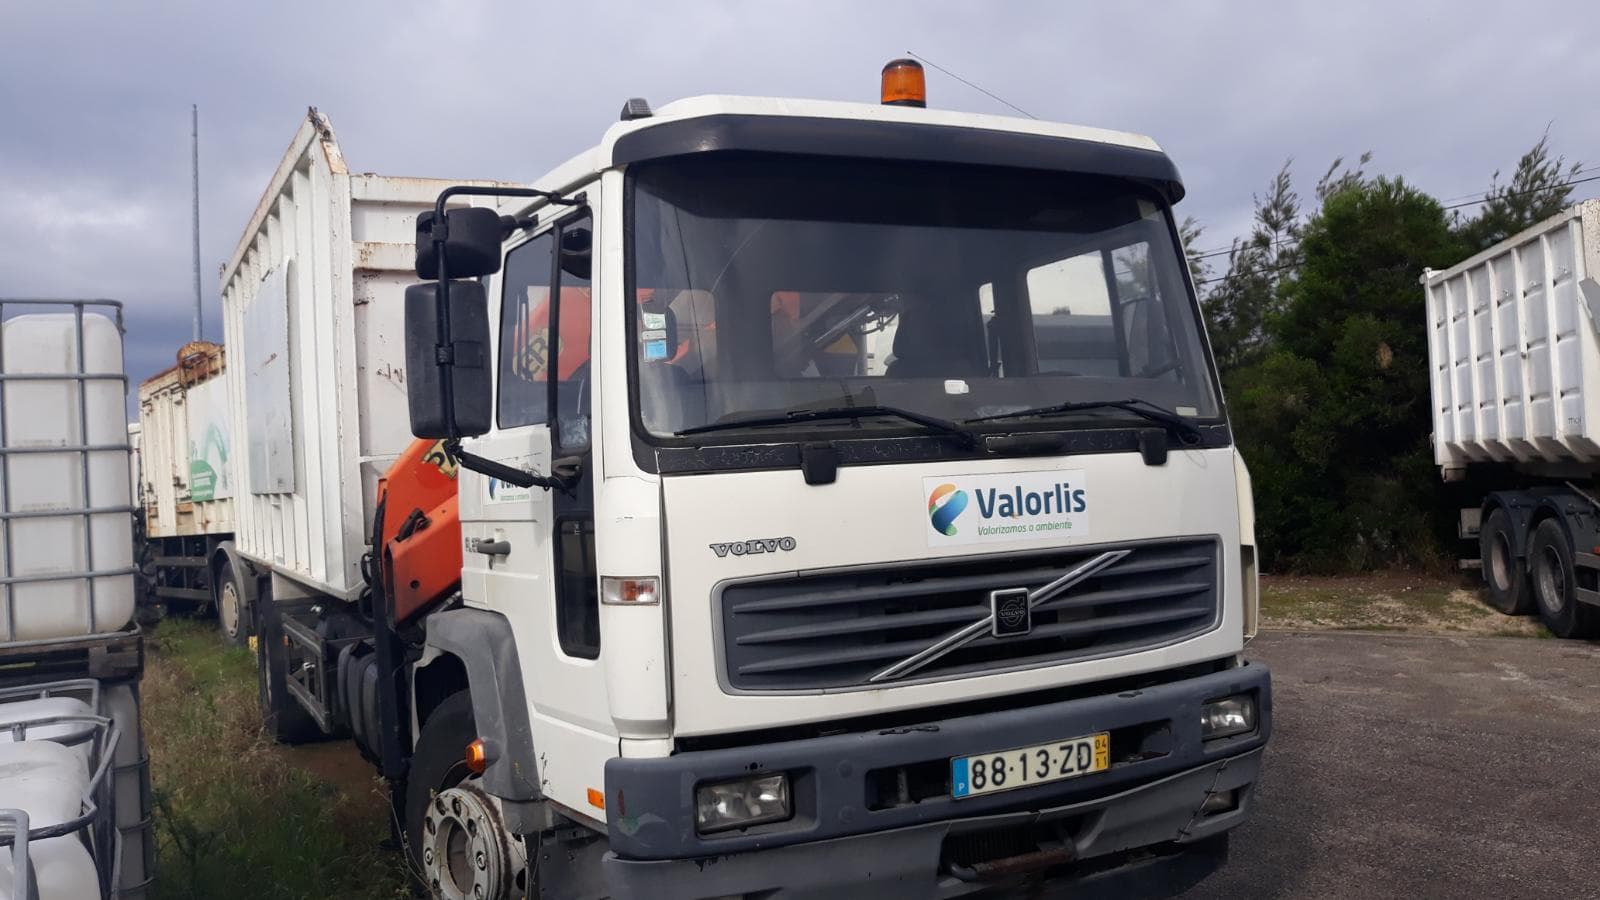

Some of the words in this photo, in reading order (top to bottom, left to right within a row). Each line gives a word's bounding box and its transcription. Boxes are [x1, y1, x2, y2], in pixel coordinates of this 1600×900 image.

[975, 483, 1086, 519] Valorlis
[977, 525, 1027, 536] Valorizamos
[1036, 521, 1073, 531] ambiente
[709, 536, 796, 558] VOLVO
[1095, 739, 1107, 750] 04
[1096, 757, 1107, 769] 11
[958, 783, 965, 791] P
